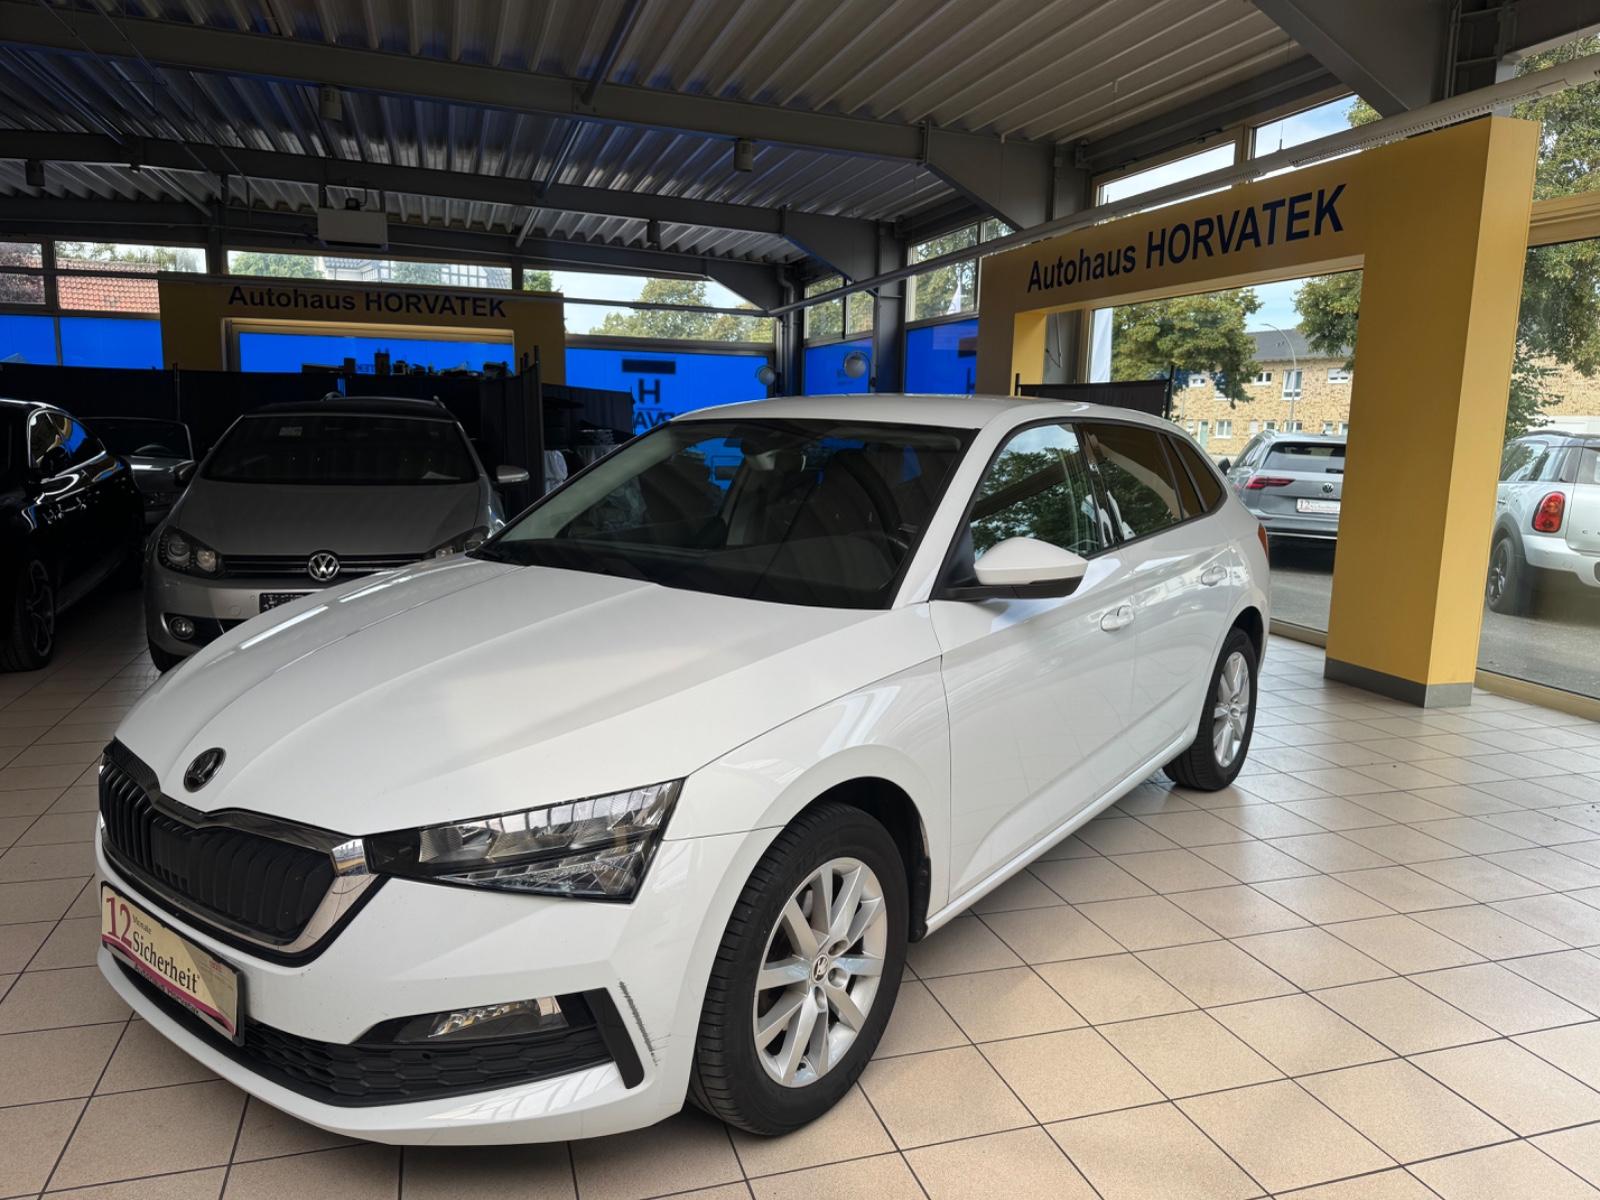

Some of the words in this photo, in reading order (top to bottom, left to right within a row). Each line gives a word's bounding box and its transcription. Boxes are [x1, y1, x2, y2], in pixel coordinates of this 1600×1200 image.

[1027, 244, 1136, 293] Autohaus
[1146, 184, 1347, 268] HORVATEK
[228, 286, 356, 312] Autohaus
[365, 292, 507, 319] HORVATEK
[106, 896, 132, 949] 12
